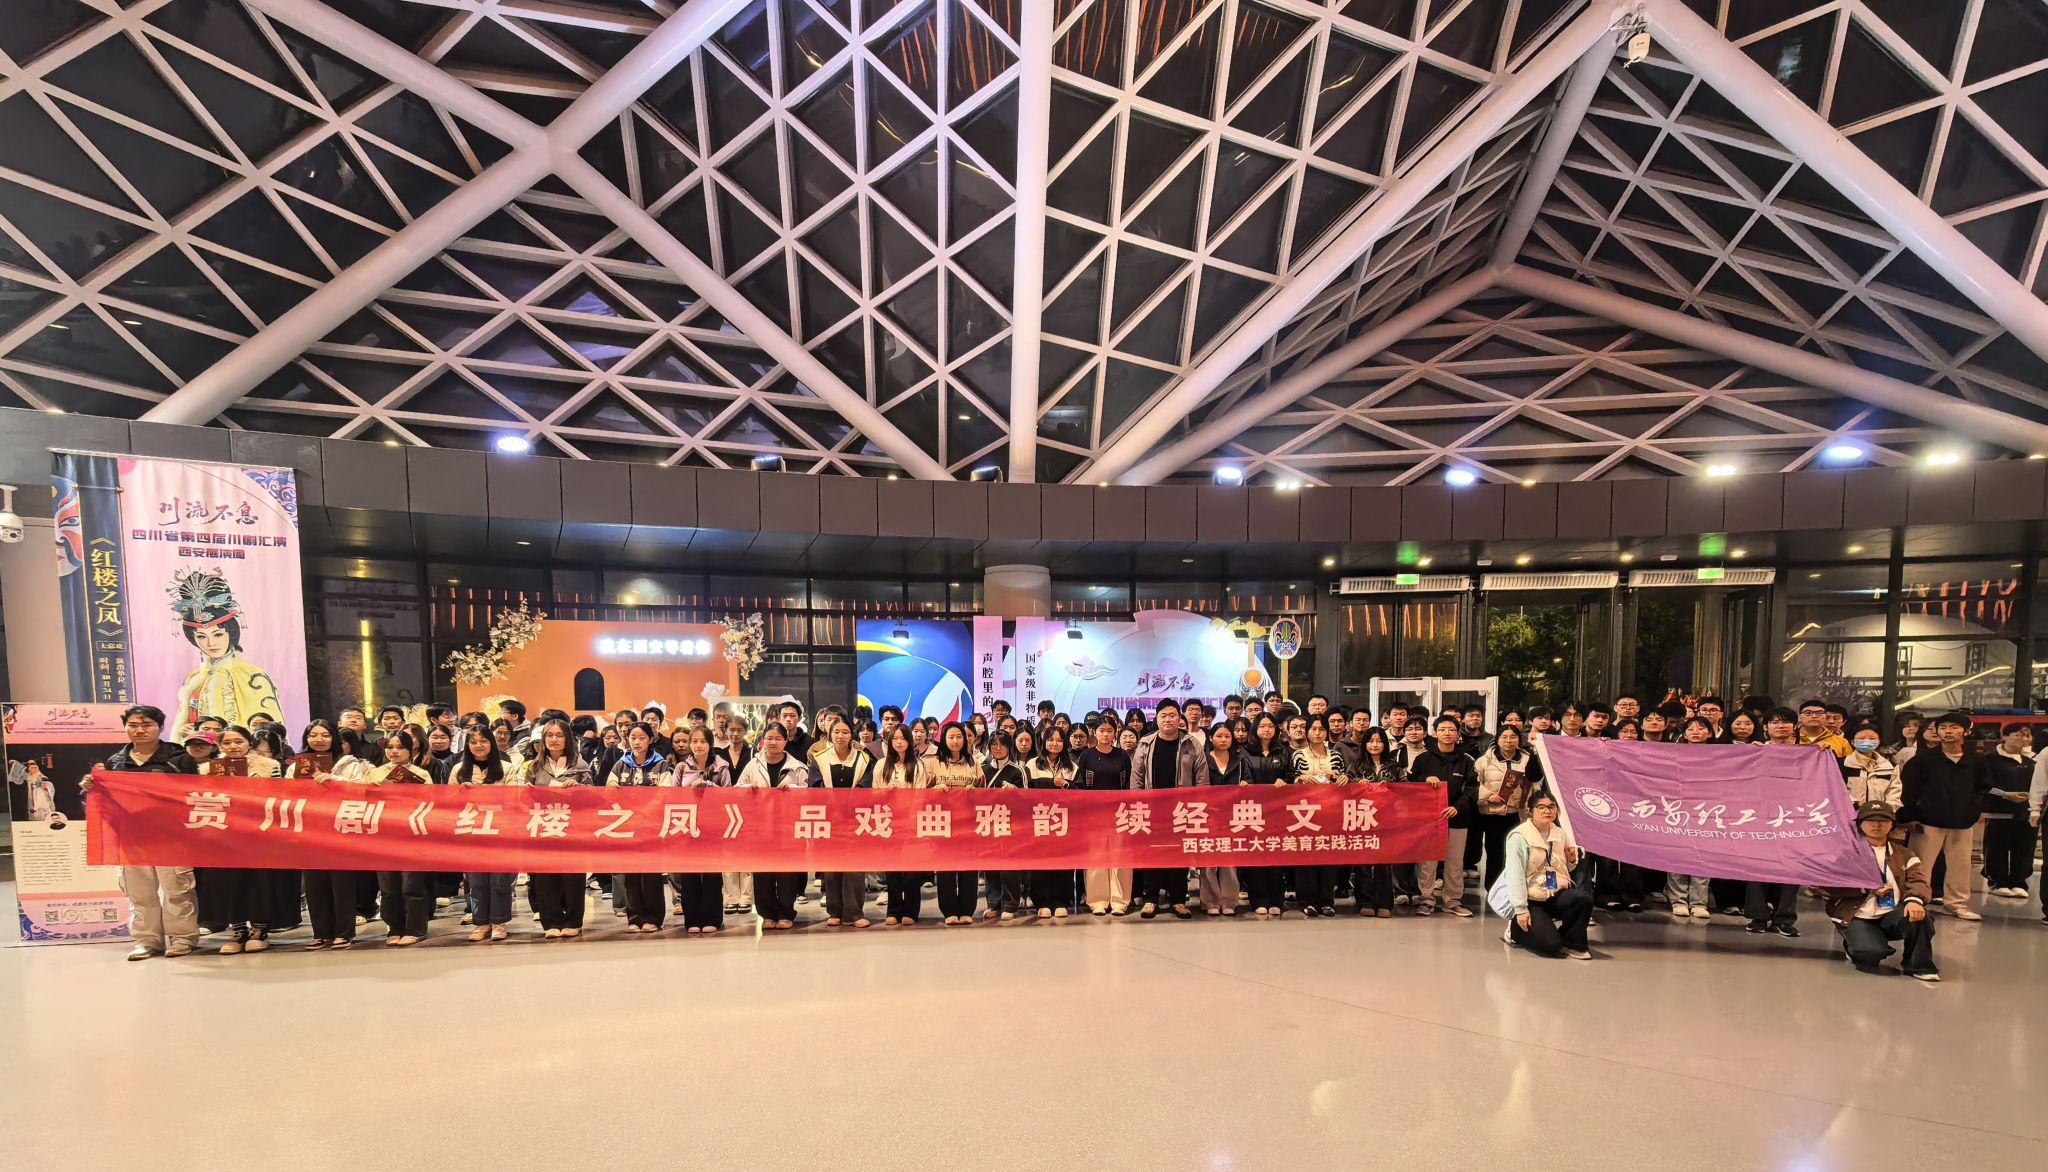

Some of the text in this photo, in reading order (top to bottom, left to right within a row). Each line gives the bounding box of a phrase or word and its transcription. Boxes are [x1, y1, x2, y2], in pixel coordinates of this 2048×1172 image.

[158, 497, 258, 526] 川流不息
[132, 529, 287, 547] 四川省第四届川剧汇演
[89, 537, 124, 637] 《红楼之凤》
[982, 653, 993, 707] 声腔里的
[184, 791, 1379, 839] 赏川剧《红楼之凤》 品戏曲雅韵 续经典文脉
[1628, 796, 1829, 828] 西安理工大学
[1632, 822, 1838, 840] XI'AN UNIVERSITY OF TECHNOLOGY
